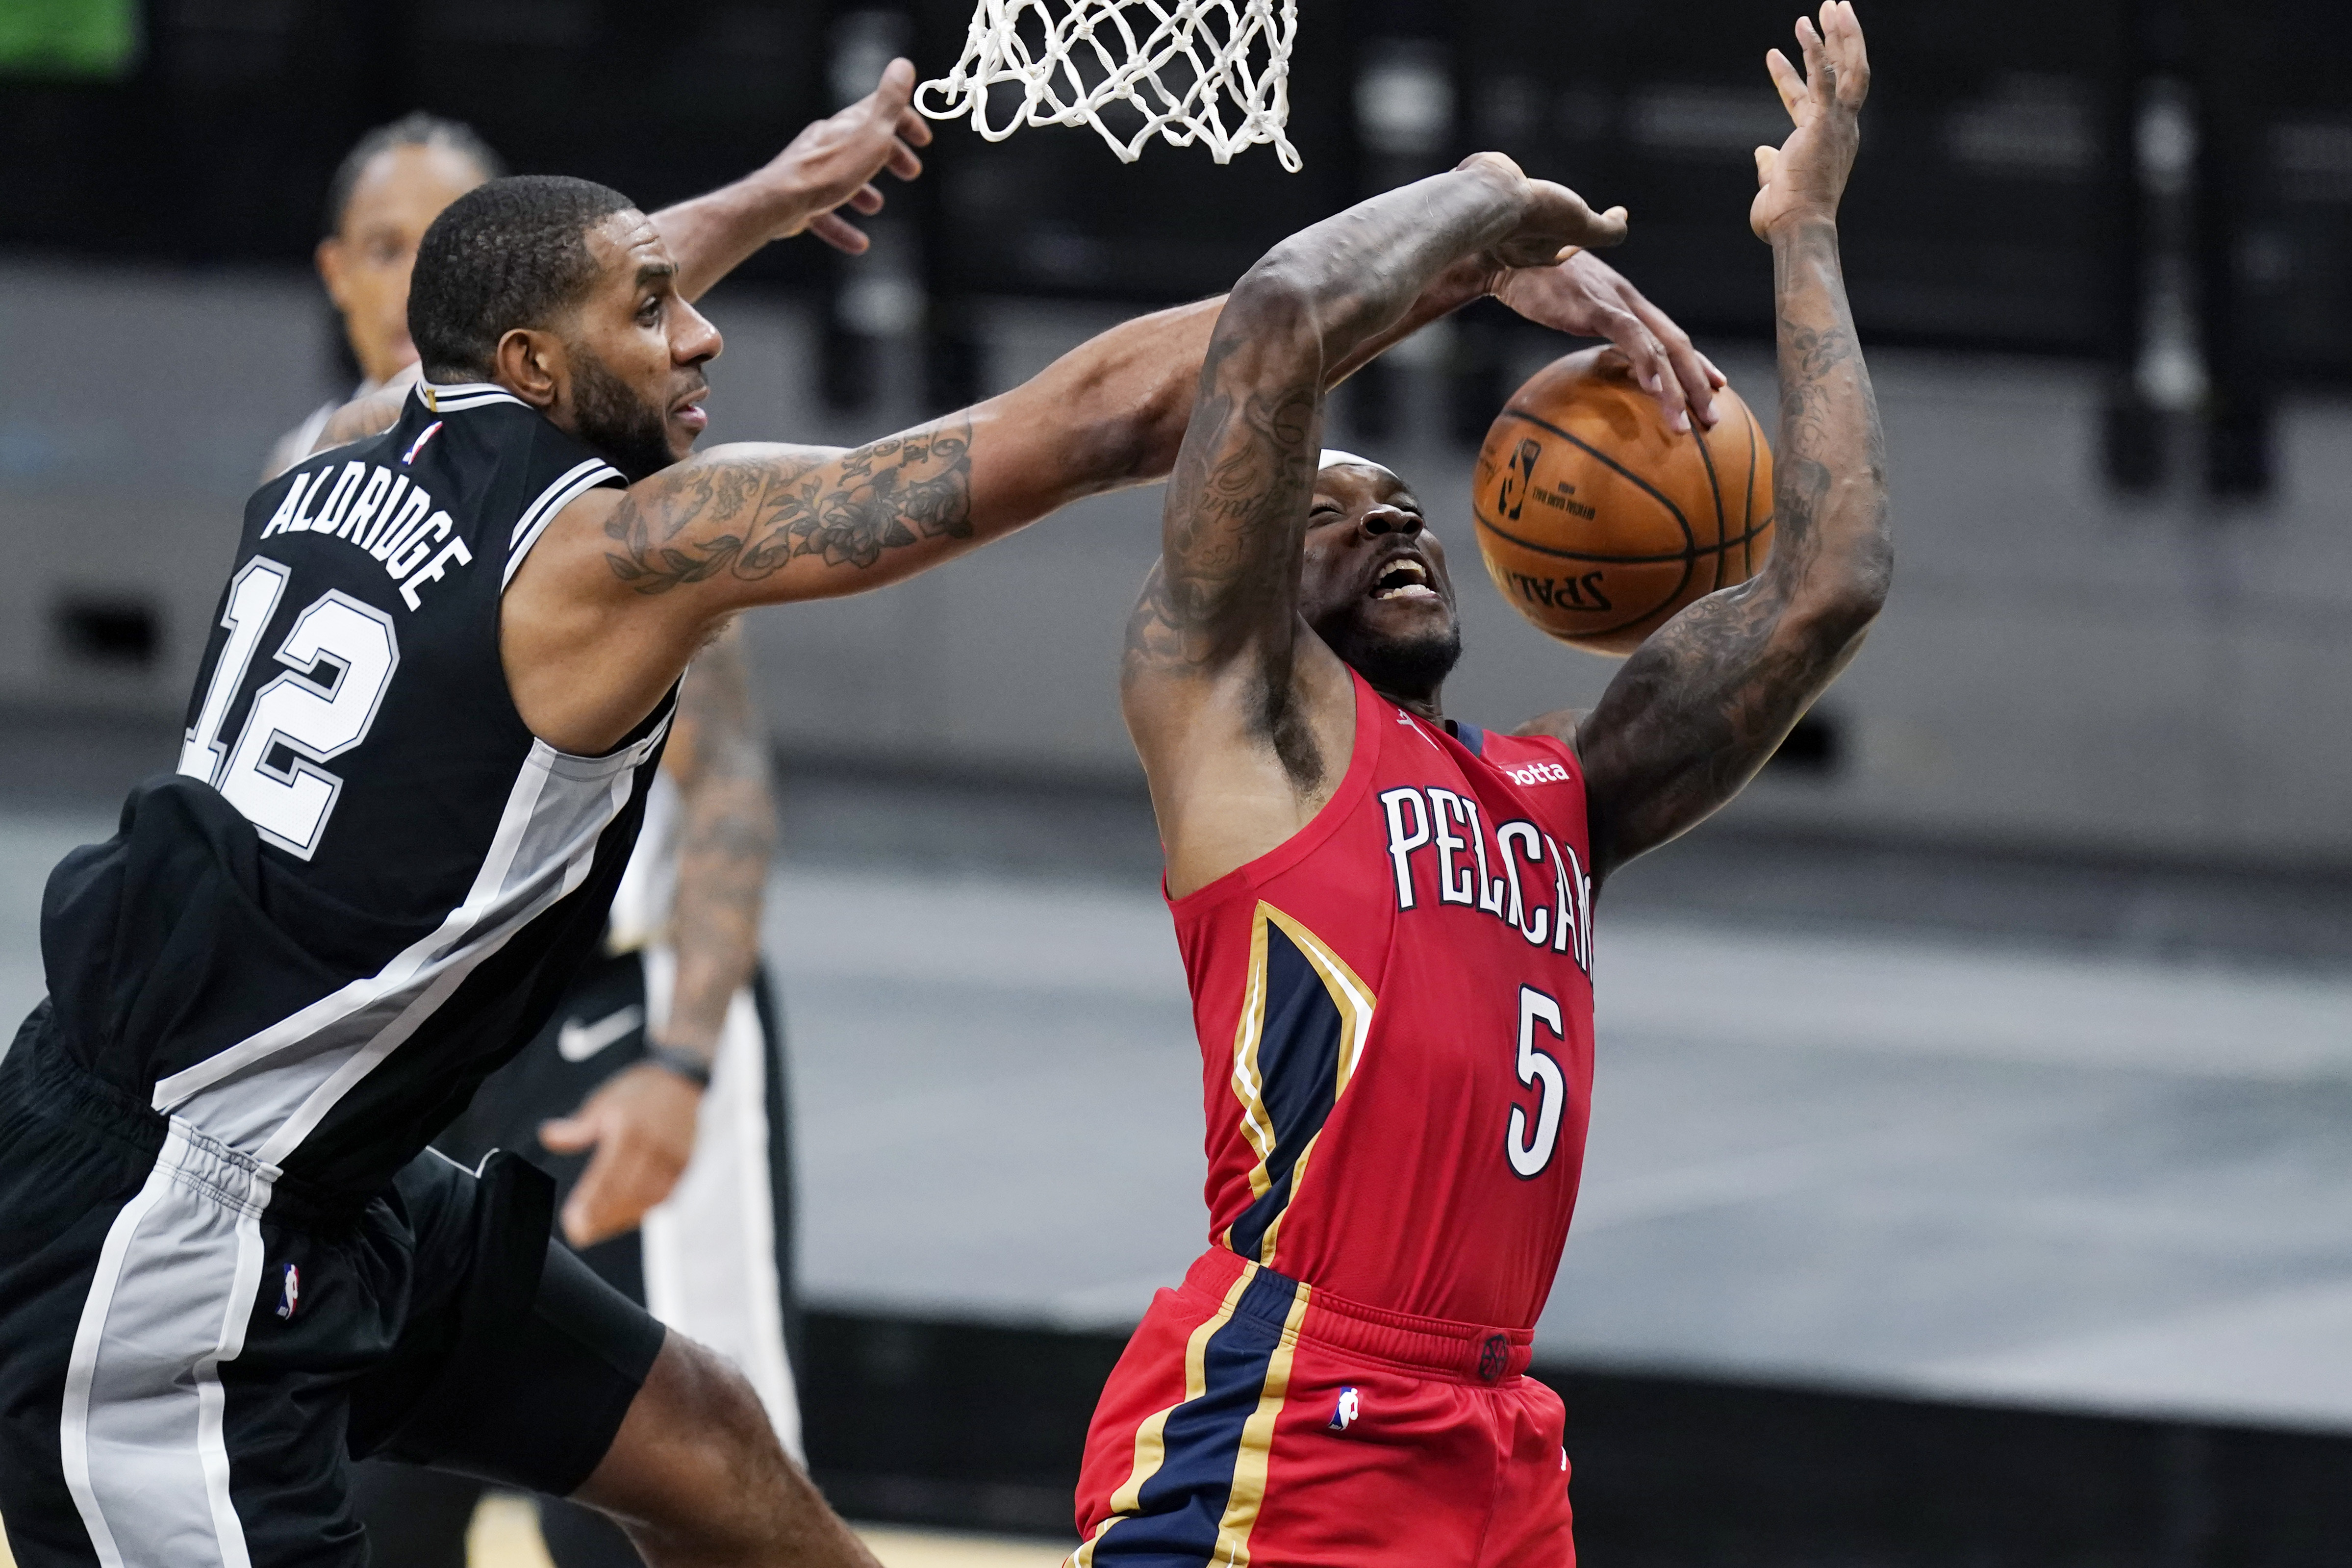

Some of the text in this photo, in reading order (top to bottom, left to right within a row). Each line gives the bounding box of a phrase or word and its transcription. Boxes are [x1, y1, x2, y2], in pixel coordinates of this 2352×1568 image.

[260, 461, 473, 611] ALDRIDGE
[177, 555, 400, 861] 12
[1505, 983, 1567, 1180] 5
